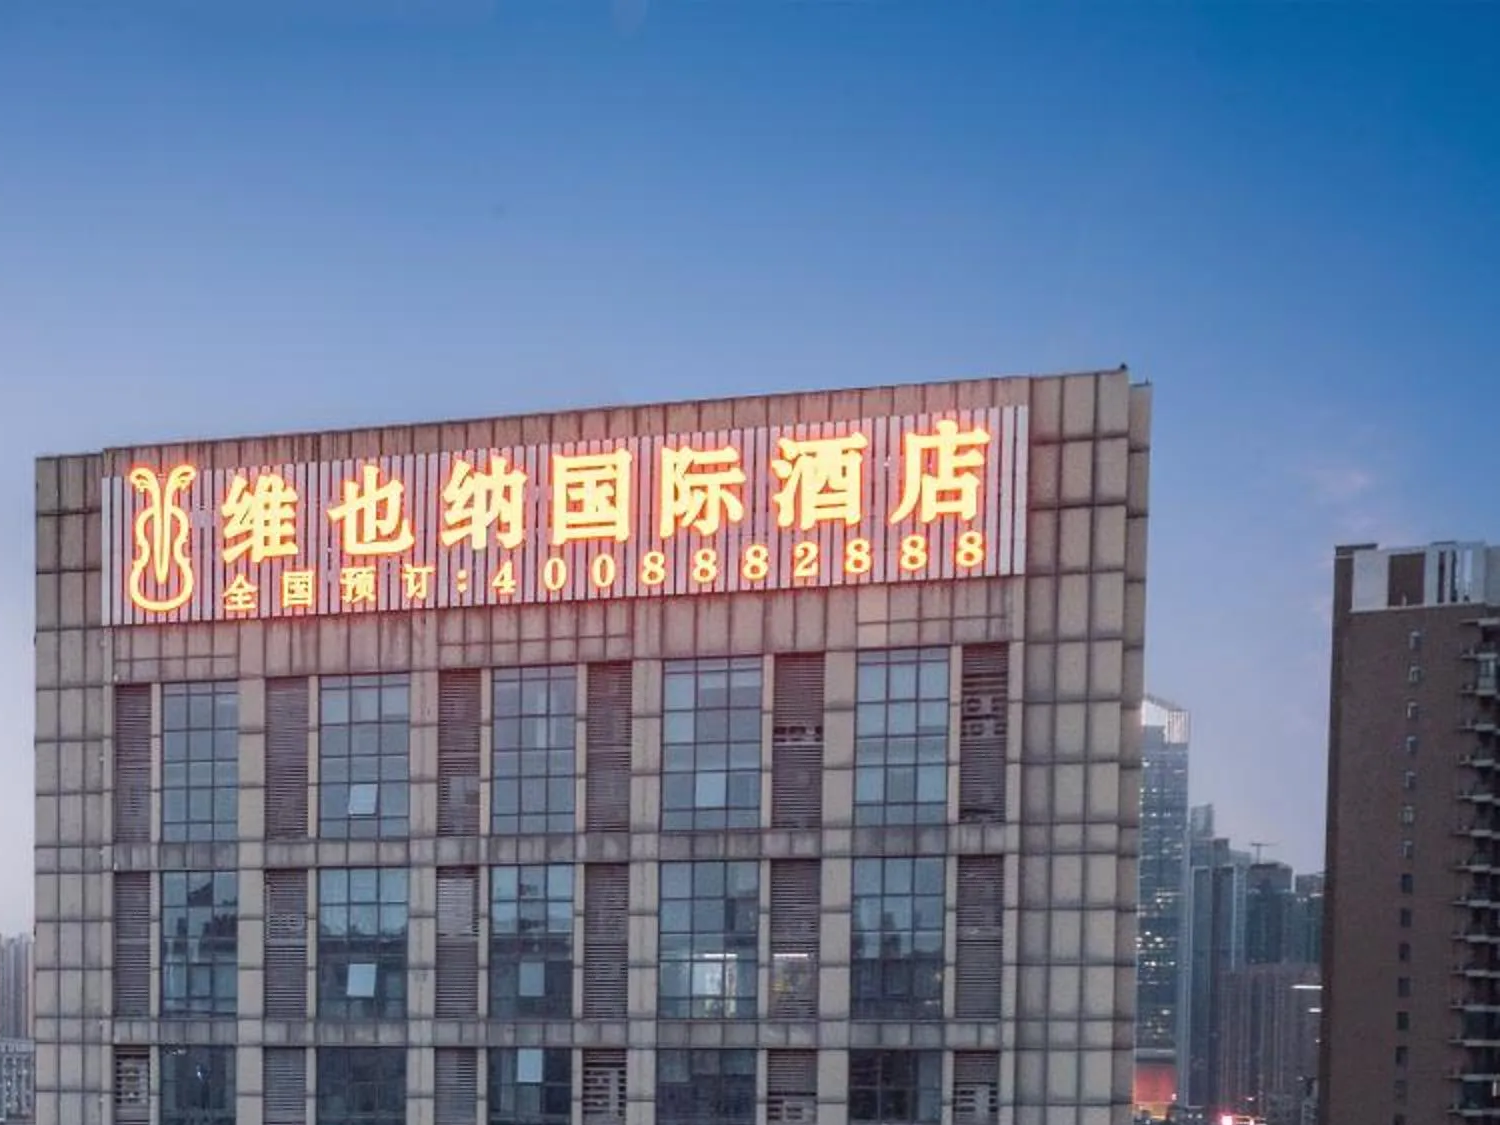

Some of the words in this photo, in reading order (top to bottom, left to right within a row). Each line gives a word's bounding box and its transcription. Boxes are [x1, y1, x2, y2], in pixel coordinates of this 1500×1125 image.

[221, 420, 991, 563] 维也纳国际酒店
